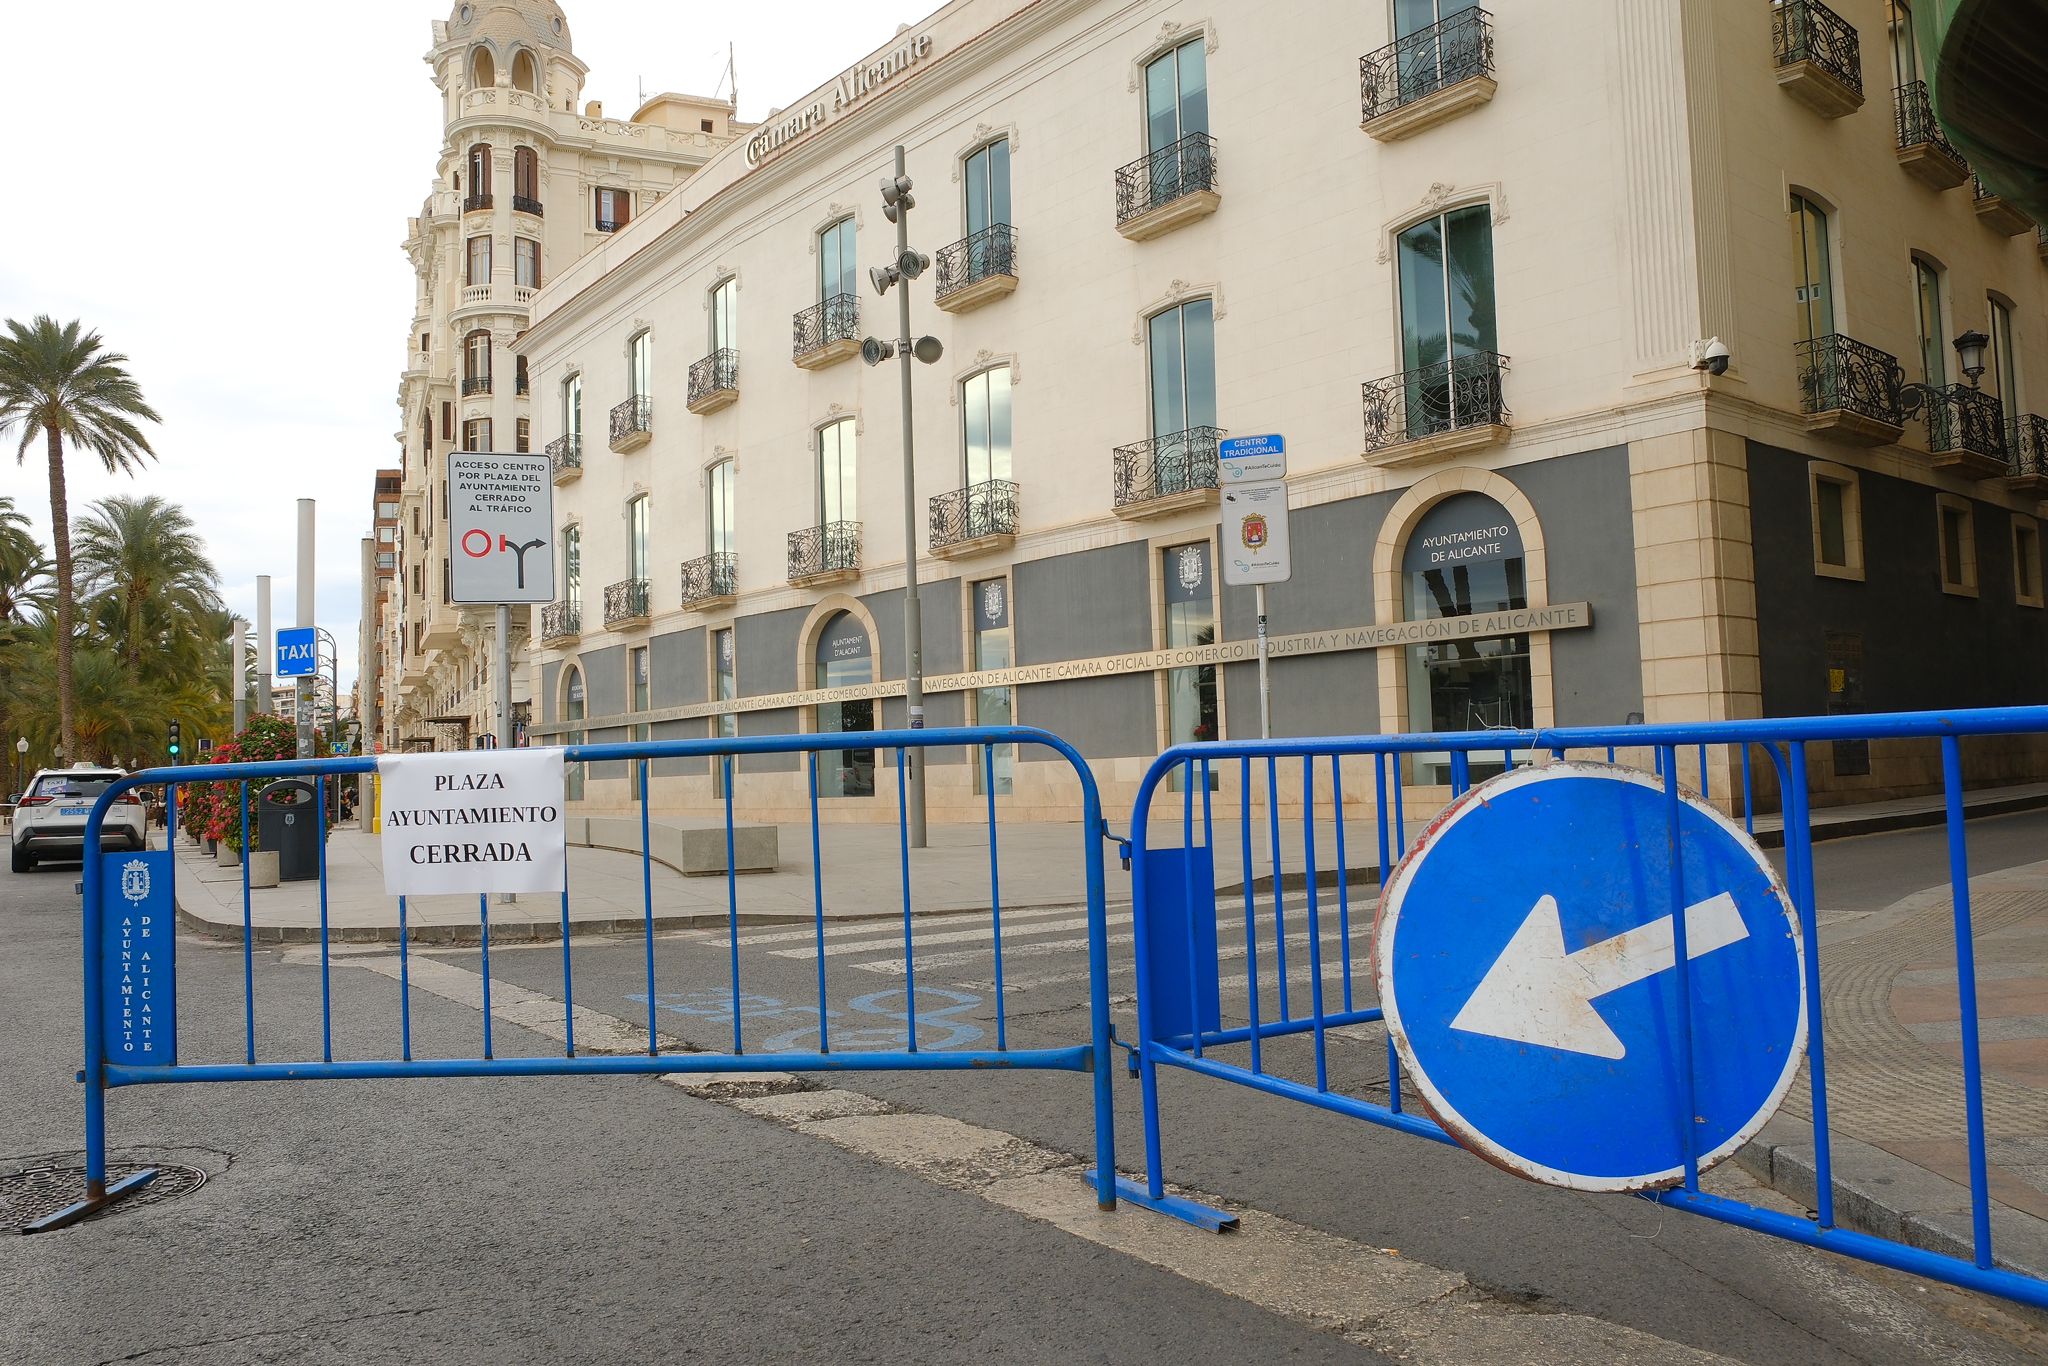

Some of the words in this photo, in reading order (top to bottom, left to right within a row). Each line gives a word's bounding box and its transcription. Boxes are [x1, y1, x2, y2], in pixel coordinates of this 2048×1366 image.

[744, 101, 825, 170] Cámara
[832, 33, 932, 113] Alicante
[1224, 445, 1279, 457] TRADICIONAL
[1234, 437, 1268, 448] CENTRO
[455, 461, 499, 470] ACCESO
[502, 463, 545, 472] CENTRO
[458, 472, 480, 480] POR
[484, 472, 518, 481] PLAZA
[521, 474, 541, 482] DEL
[459, 483, 541, 492] AYUNTAMIENTO
[475, 494, 526, 502] CERRADO
[469, 504, 482, 512] AL
[486, 504, 532, 513] TRÁFICO
[1422, 525, 1509, 549] AYUNTAMIENTO
[1431, 551, 1445, 563] DE
[1448, 543, 1501, 560] ALICANTE
[1330, 634, 1339, 647] Y
[1345, 621, 1450, 646] NAVEGACIÓN
[1459, 615, 1480, 633] DE
[1485, 608, 1577, 631] ALICANTE
[832, 635, 863, 647] AJUNTAMENT
[279, 643, 314, 660] TAXI
[834, 646, 861, 657] D'ALACANT
[1057, 661, 1102, 677] CÁMARA
[1107, 656, 1151, 670] OFICIAL
[1156, 654, 1171, 666] DE
[1176, 645, 1244, 663] COMERCIO
[925, 673, 986, 691] NAVEGACIÓN
[988, 673, 1000, 684] DE
[1003, 668, 1052, 682] ALICANTE
[724, 698, 754, 711] ALICANTE
[758, 694, 785, 708] CÁMARA
[816, 691, 827, 701] DE
[828, 687, 867, 700] COMERCIO
[872, 684, 906, 696] INDUSTR
[434, 773, 505, 791] PLAZA
[387, 806, 557, 827] AYUNTAMIENTO
[409, 842, 533, 864] CERRADA
[141, 916, 151, 938] DE
[121, 917, 134, 1052] AYUNTAMIENTO
[141, 951, 152, 1051] ALICANTE
